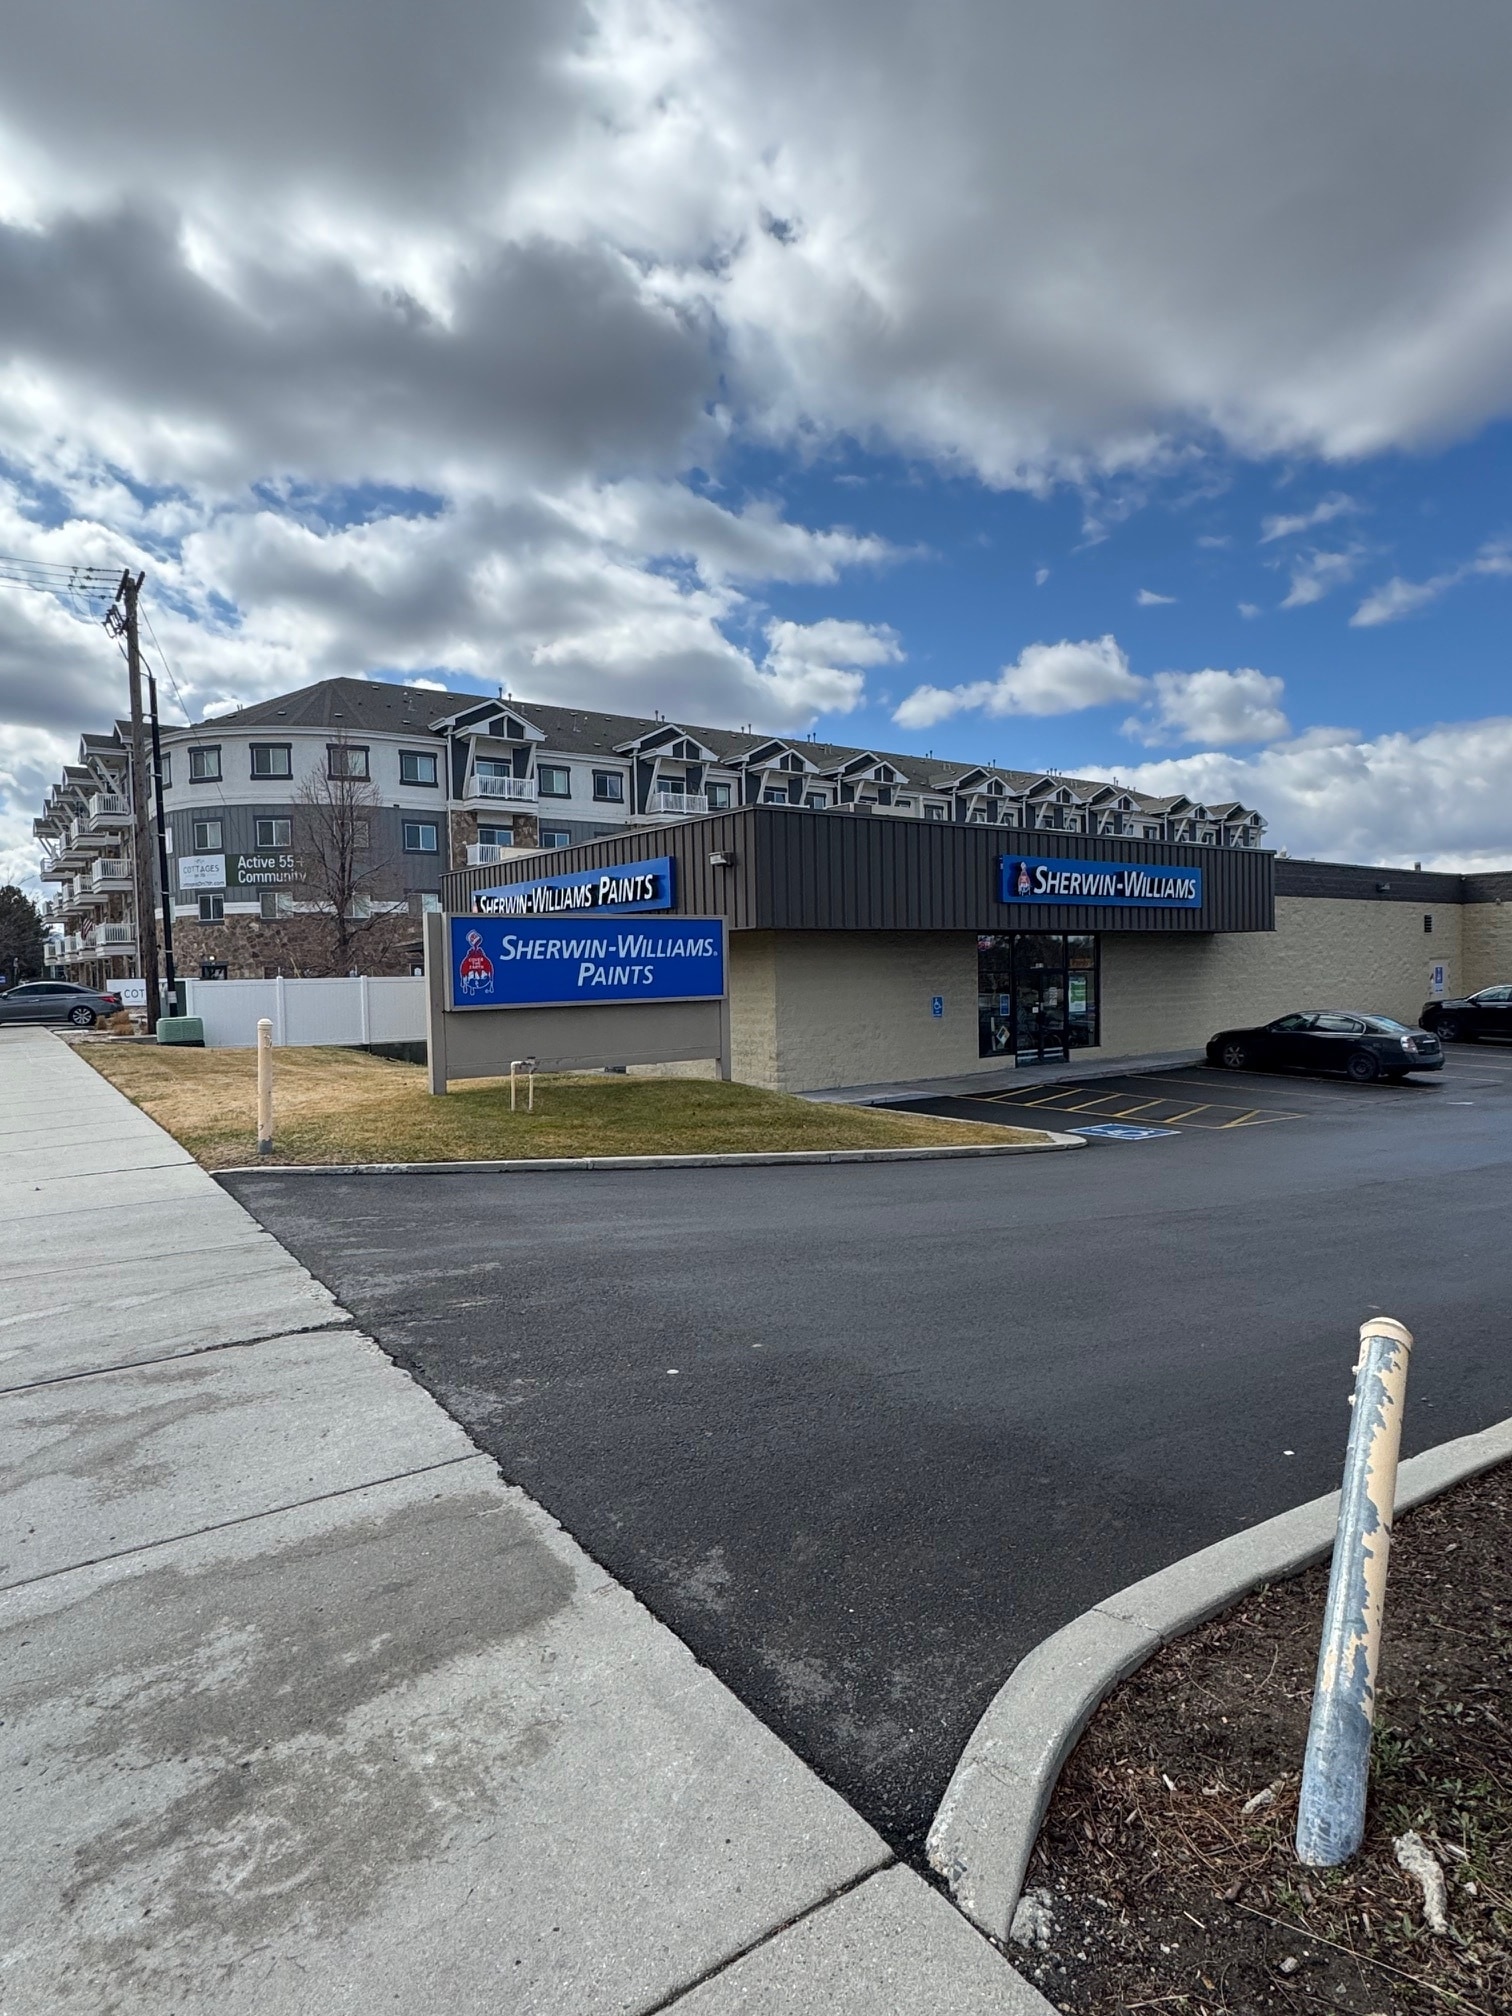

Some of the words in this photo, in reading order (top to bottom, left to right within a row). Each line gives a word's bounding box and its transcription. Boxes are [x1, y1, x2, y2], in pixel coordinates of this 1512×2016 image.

[182, 864, 220, 875] COTTAGES
[237, 855, 276, 869] Active
[237, 868, 307, 883] Community
[1033, 866, 1196, 899] SHERWIN-WILLIAMS
[480, 885, 592, 913] SHERWIN-WILLIAMS
[598, 873, 654, 906] PAINTS
[499, 934, 714, 961] SHERWIN-WILLIAMS
[577, 962, 655, 987] PAINTS
